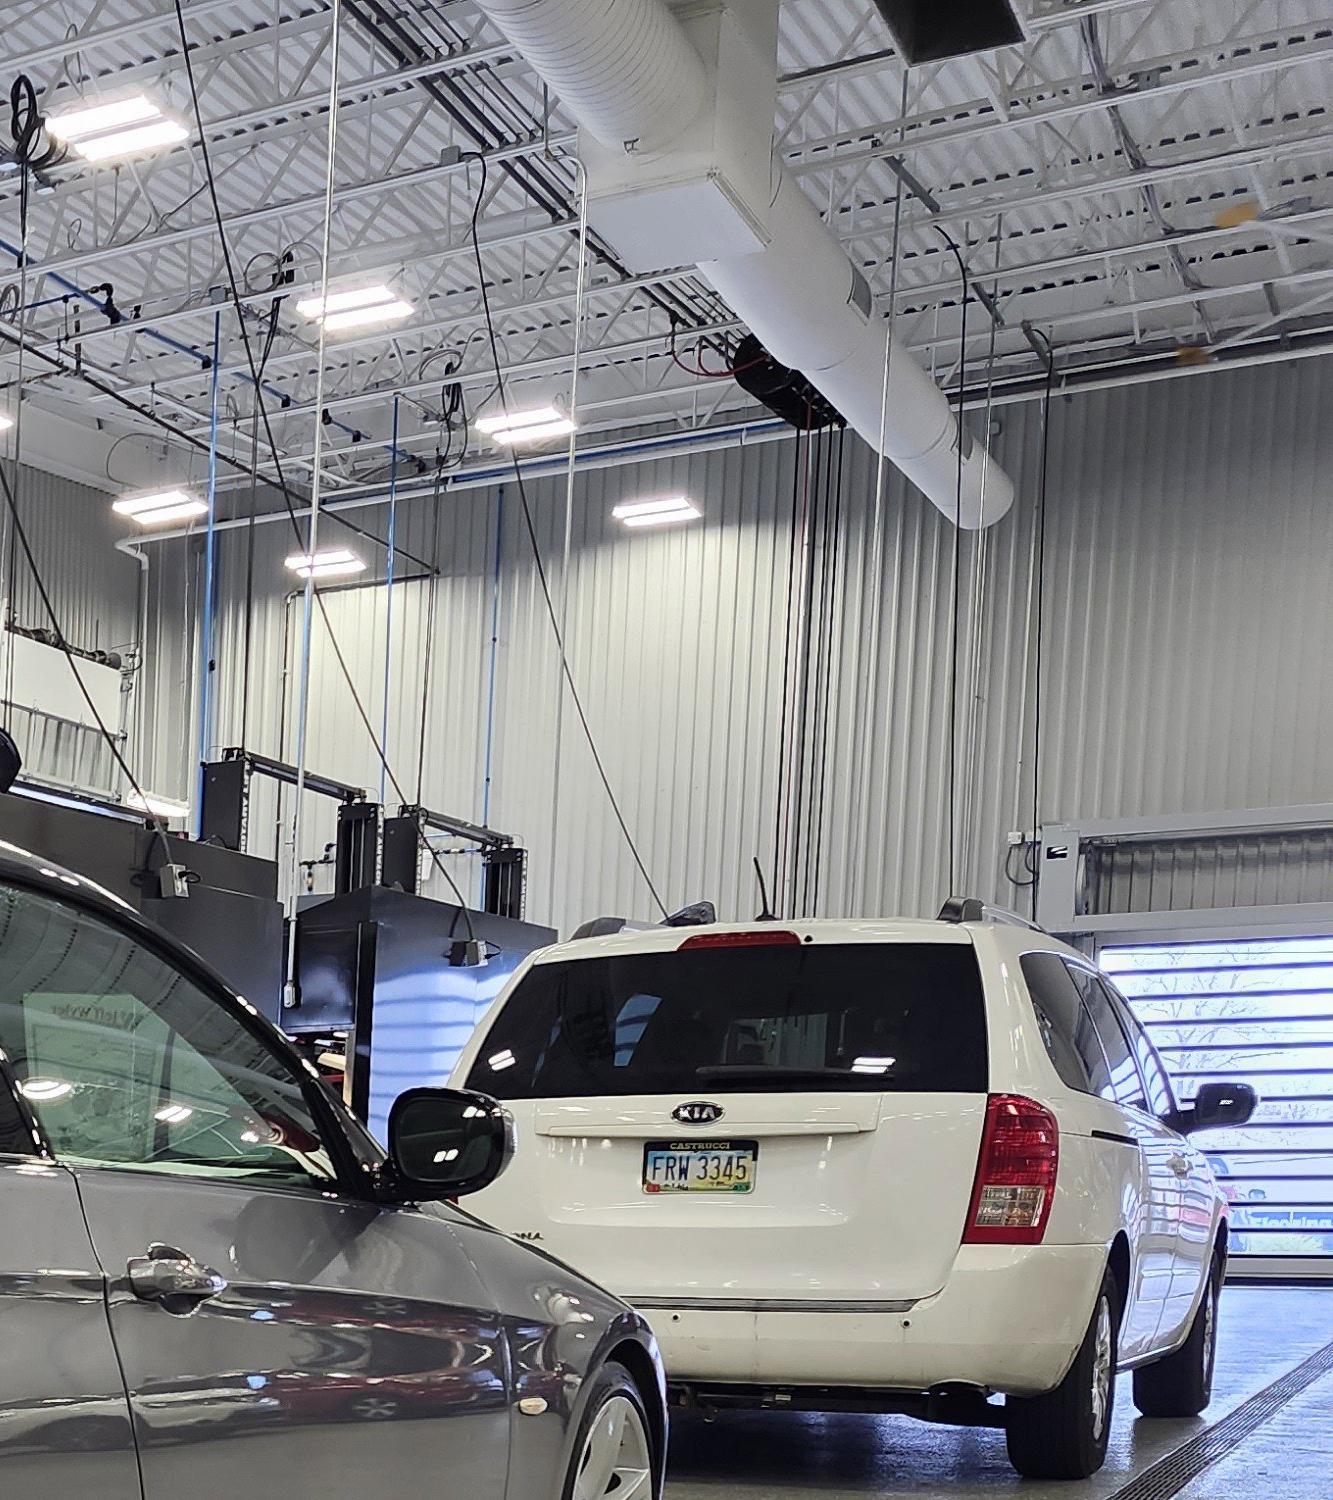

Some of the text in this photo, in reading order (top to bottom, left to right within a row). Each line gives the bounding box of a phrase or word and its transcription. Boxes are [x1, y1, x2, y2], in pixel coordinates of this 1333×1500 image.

[678, 1105, 716, 1120] KIA
[653, 1155, 748, 1181] FRW 3345
